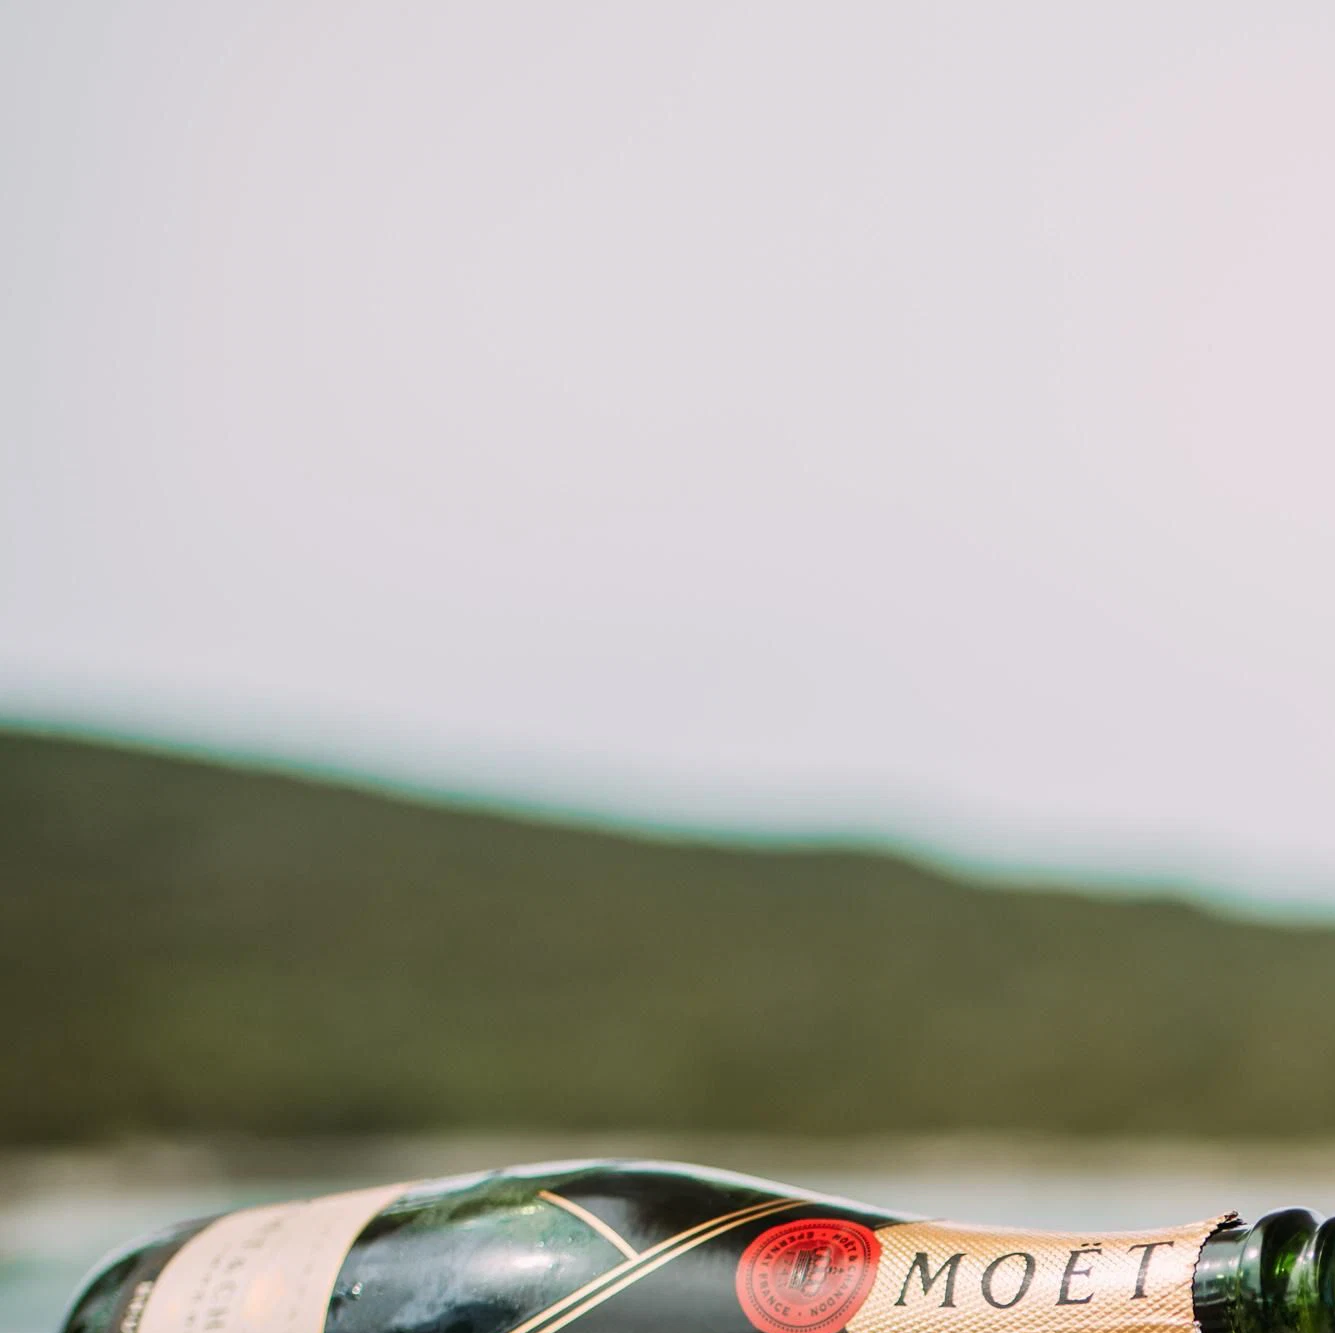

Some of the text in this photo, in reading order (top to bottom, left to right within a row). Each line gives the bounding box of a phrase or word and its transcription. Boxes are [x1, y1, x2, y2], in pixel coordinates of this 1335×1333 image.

[758, 1272, 791, 1316] FRANCE
[809, 1264, 857, 1316] CHANDON
[894, 1241, 1174, 1309] MOËT
